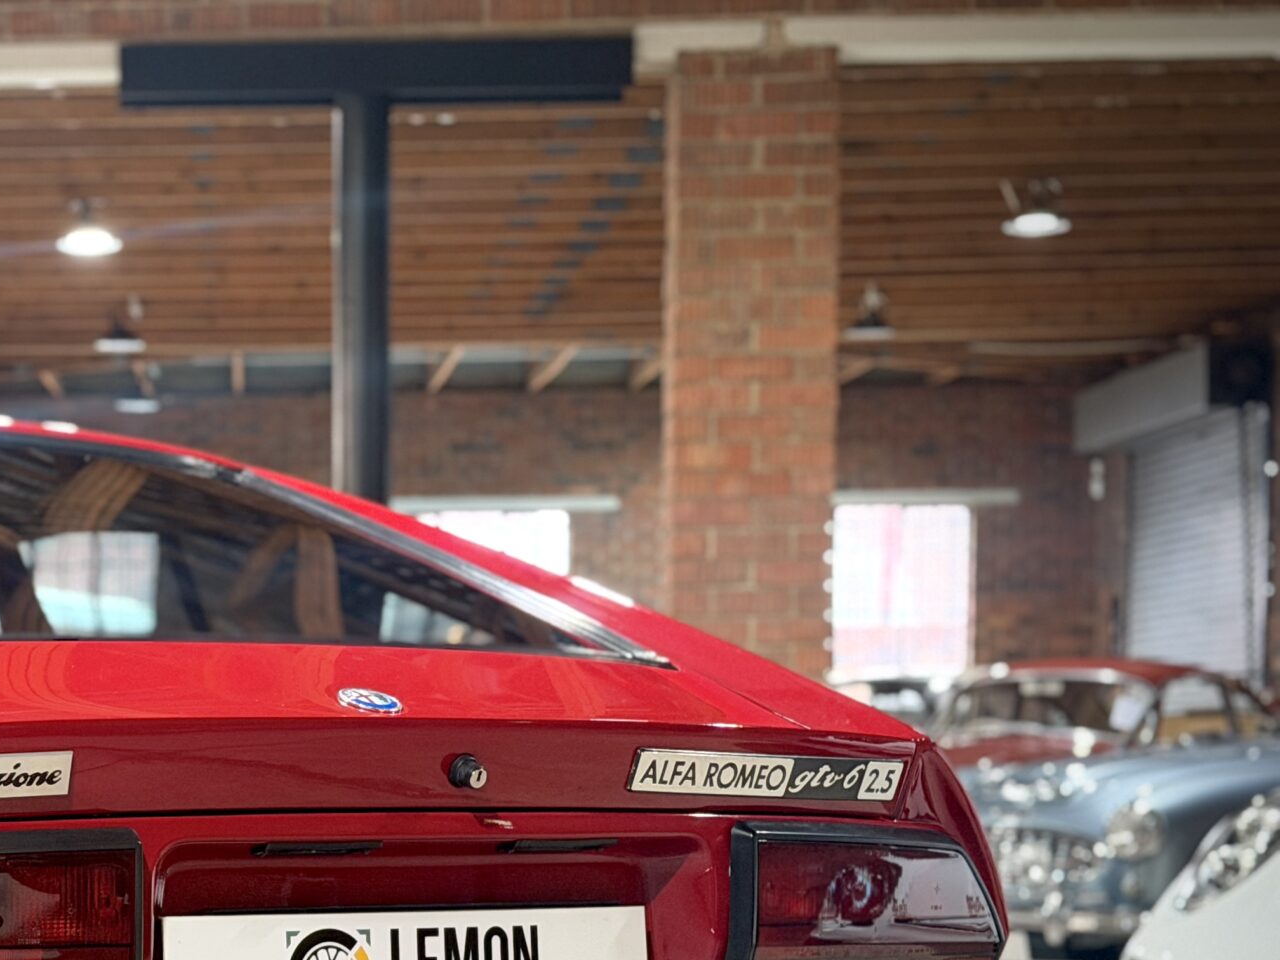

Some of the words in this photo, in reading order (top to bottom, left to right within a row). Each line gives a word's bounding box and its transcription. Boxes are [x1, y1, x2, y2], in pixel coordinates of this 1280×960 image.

[639, 759, 696, 787] ALFA
[703, 762, 787, 791] ROMEO
[865, 768, 897, 794] 2.5
